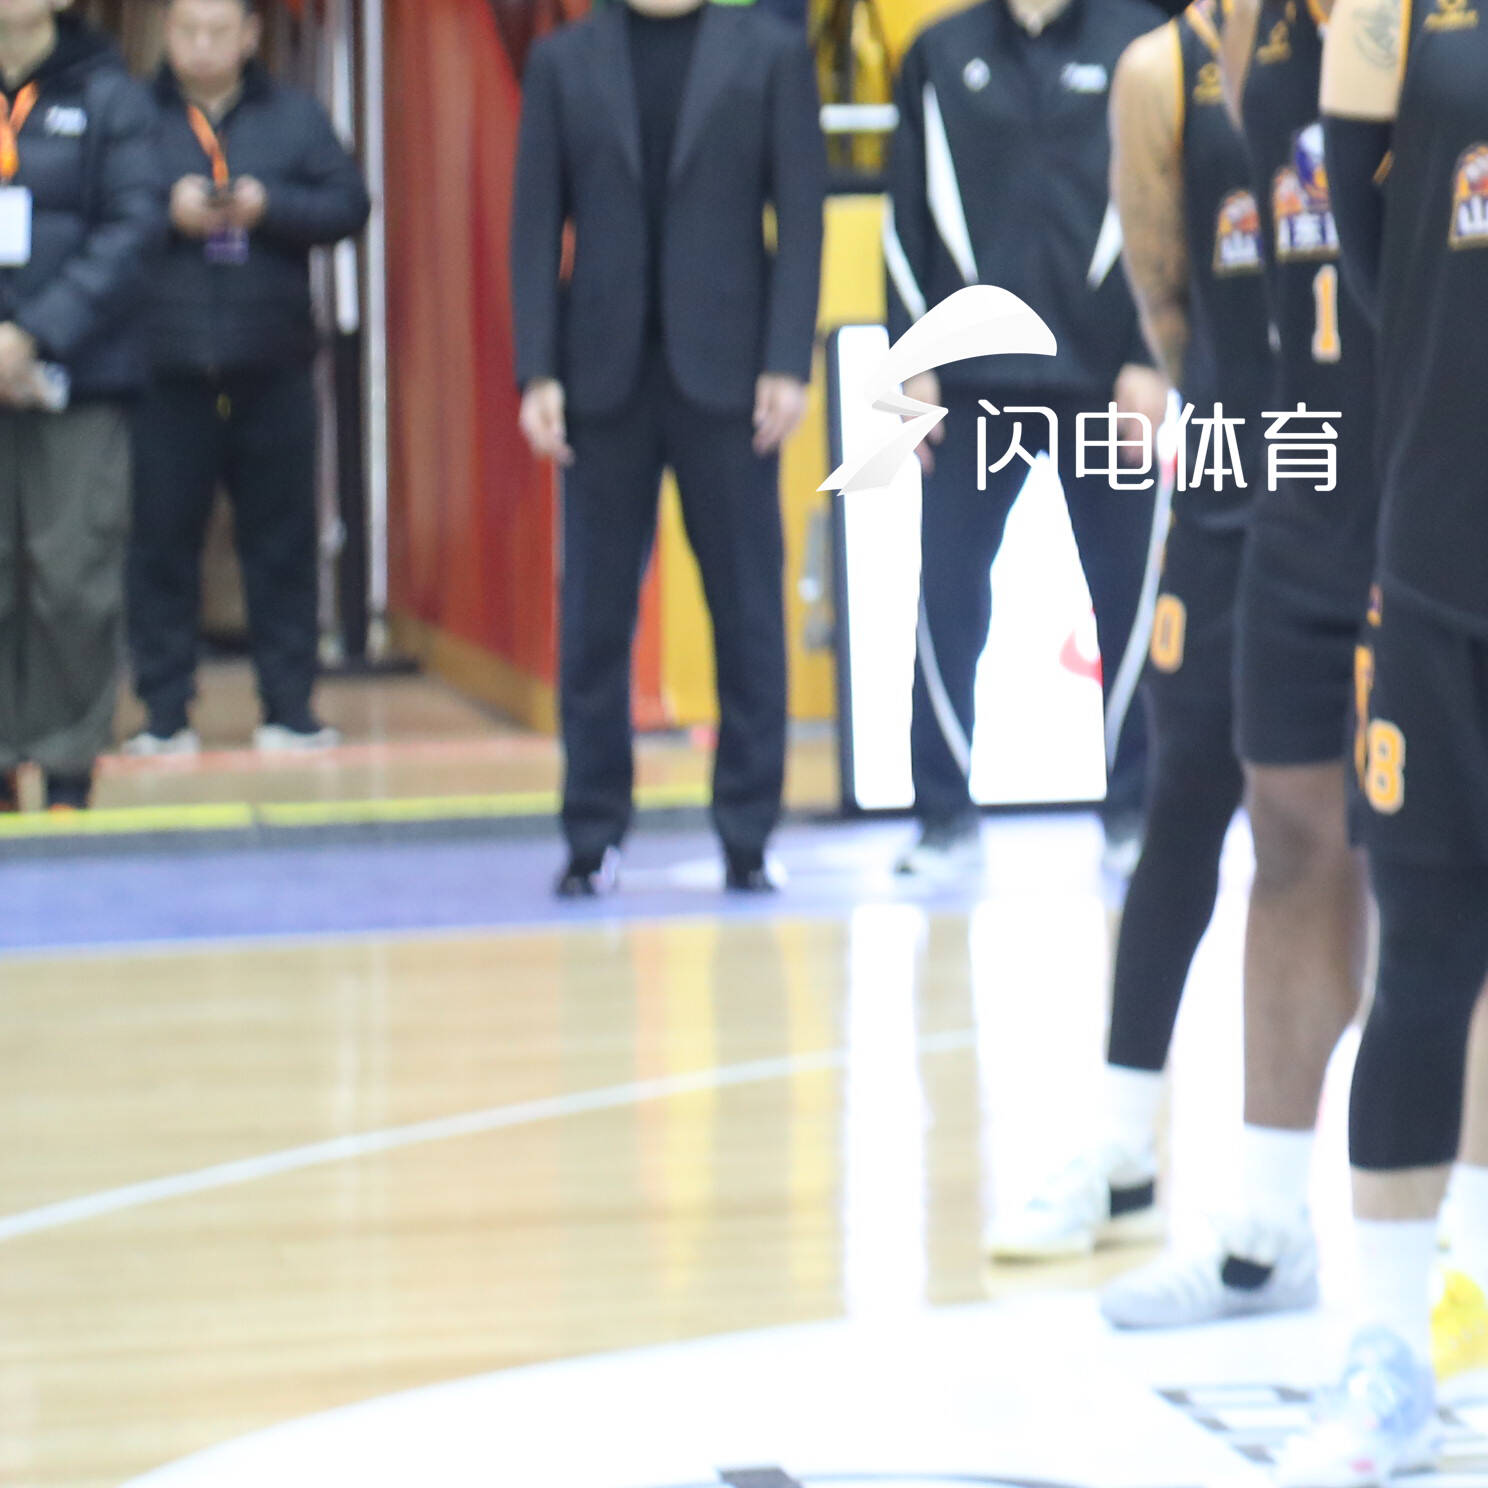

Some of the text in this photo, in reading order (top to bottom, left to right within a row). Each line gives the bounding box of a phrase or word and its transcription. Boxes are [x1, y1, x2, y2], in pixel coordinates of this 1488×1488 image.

[1311, 263, 1342, 363] 1
[1149, 593, 1188, 674] 0
[1365, 718, 1406, 815] 8
